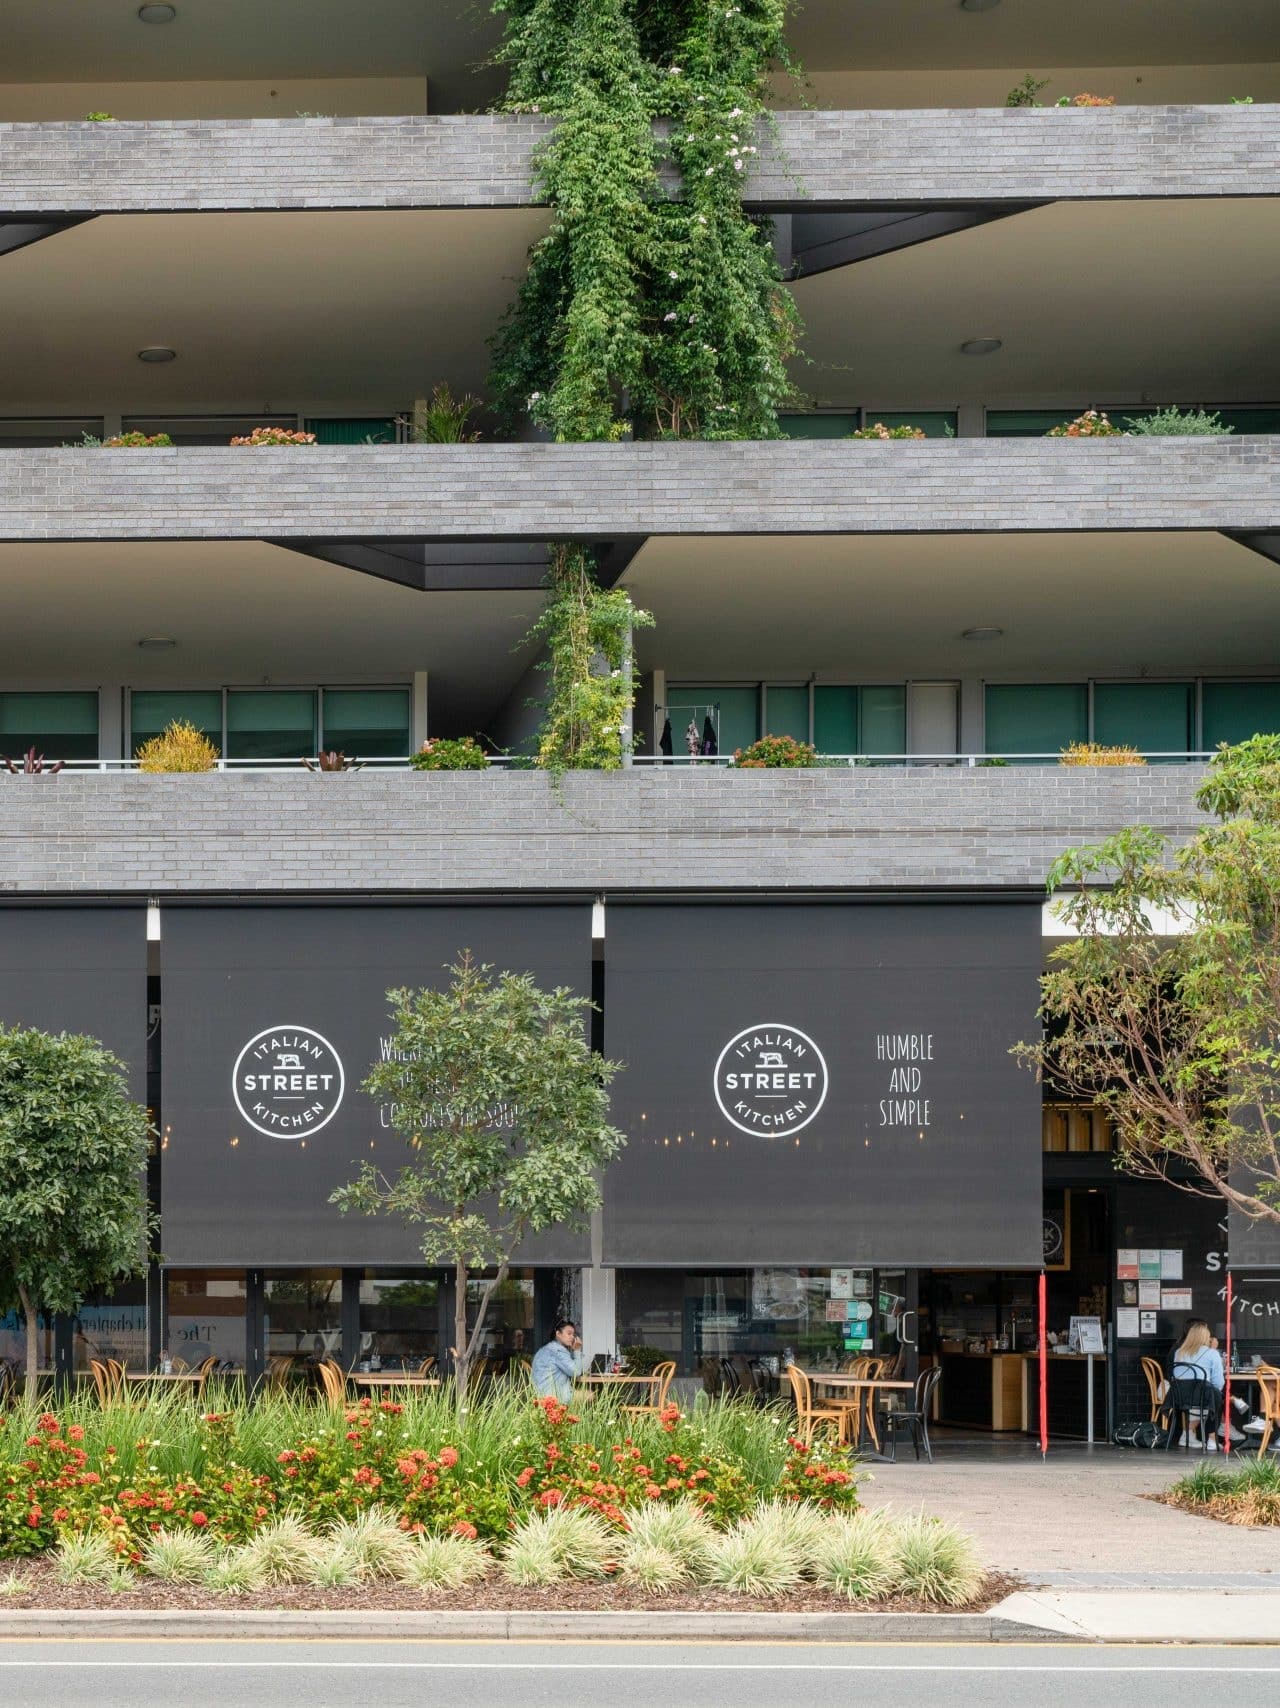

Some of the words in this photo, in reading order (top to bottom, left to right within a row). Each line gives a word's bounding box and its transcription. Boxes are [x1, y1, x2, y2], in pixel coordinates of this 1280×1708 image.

[254, 1036, 323, 1060] ITALIAN
[736, 1034, 806, 1058] ITALIAN
[877, 1034, 933, 1060] HUMBLE
[244, 1074, 333, 1091] STREET
[726, 1073, 816, 1089] STREET
[889, 1067, 921, 1092] AND
[253, 1102, 324, 1126] KITCHEN
[735, 1101, 806, 1125] KITCHEN
[880, 1099, 930, 1125] SIMPLE
